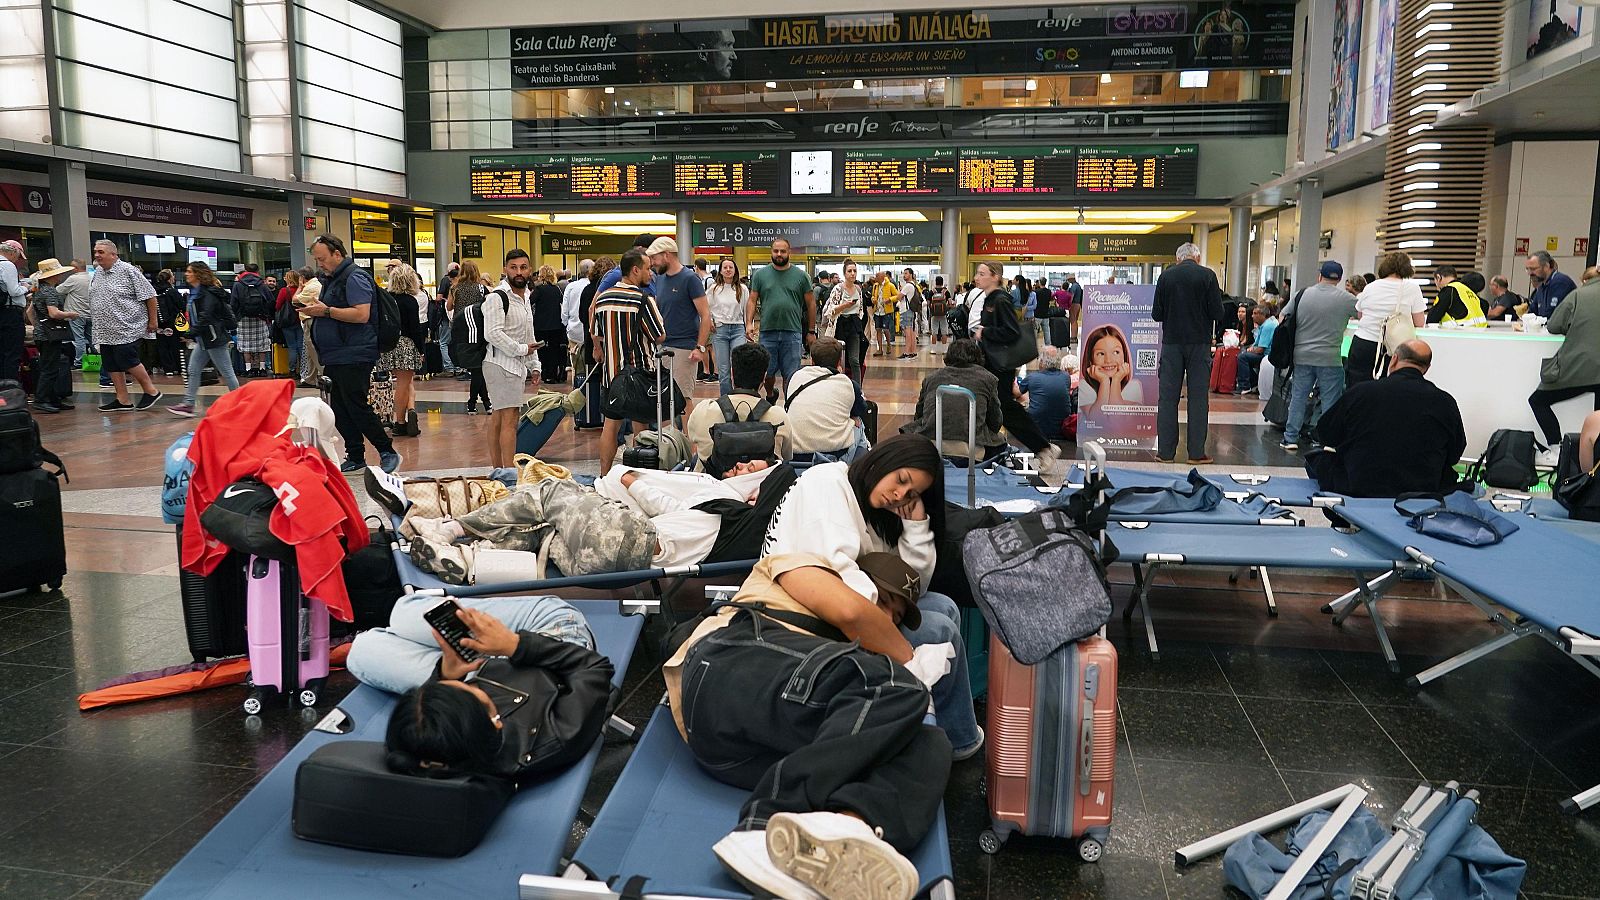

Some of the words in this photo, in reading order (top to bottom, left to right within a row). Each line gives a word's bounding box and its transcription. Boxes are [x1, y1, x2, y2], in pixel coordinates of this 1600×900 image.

[1036, 12, 1082, 32] renfe
[1114, 11, 1178, 31] GYPSY
[764, 20, 819, 47] HASTA
[826, 16, 901, 44] PRONTO
[909, 10, 992, 41] MÁLAGA
[513, 36, 543, 51] Sala
[547, 35, 576, 50] Club
[579, 33, 617, 51] Renfe
[789, 55, 804, 65] LA
[805, 51, 850, 65] EMOCIÓN
[853, 53, 867, 63] DE
[869, 51, 914, 63] ENSAYAR
[915, 51, 930, 61] UN
[932, 49, 966, 61] SUEÑO
[1110, 48, 1140, 56] ANTONIO
[1140, 46, 1174, 55] BANDERAS
[513, 65, 538, 74] Teatro
[540, 63, 552, 73] del
[554, 63, 574, 73] Soho
[575, 61, 617, 72] CaixaBank
[531, 74, 561, 84] Antonio
[563, 73, 600, 83] Banderas
[824, 116, 879, 138] renfe
[889, 121, 902, 134] Tu
[136, 202, 161, 212] Atención
[165, 205, 172, 213] al
[172, 204, 193, 215] cliente
[215, 209, 247, 220] Información
[721, 226, 744, 242] 1-8
[747, 227, 774, 235] Acceso
[783, 226, 800, 235] vías
[860, 226, 871, 235] de
[873, 225, 915, 236] equipajes
[563, 238, 592, 248] Llegadas
[995, 238, 1005, 246] No
[1007, 239, 1029, 247] pasar
[1103, 237, 1138, 247] Llegadas
